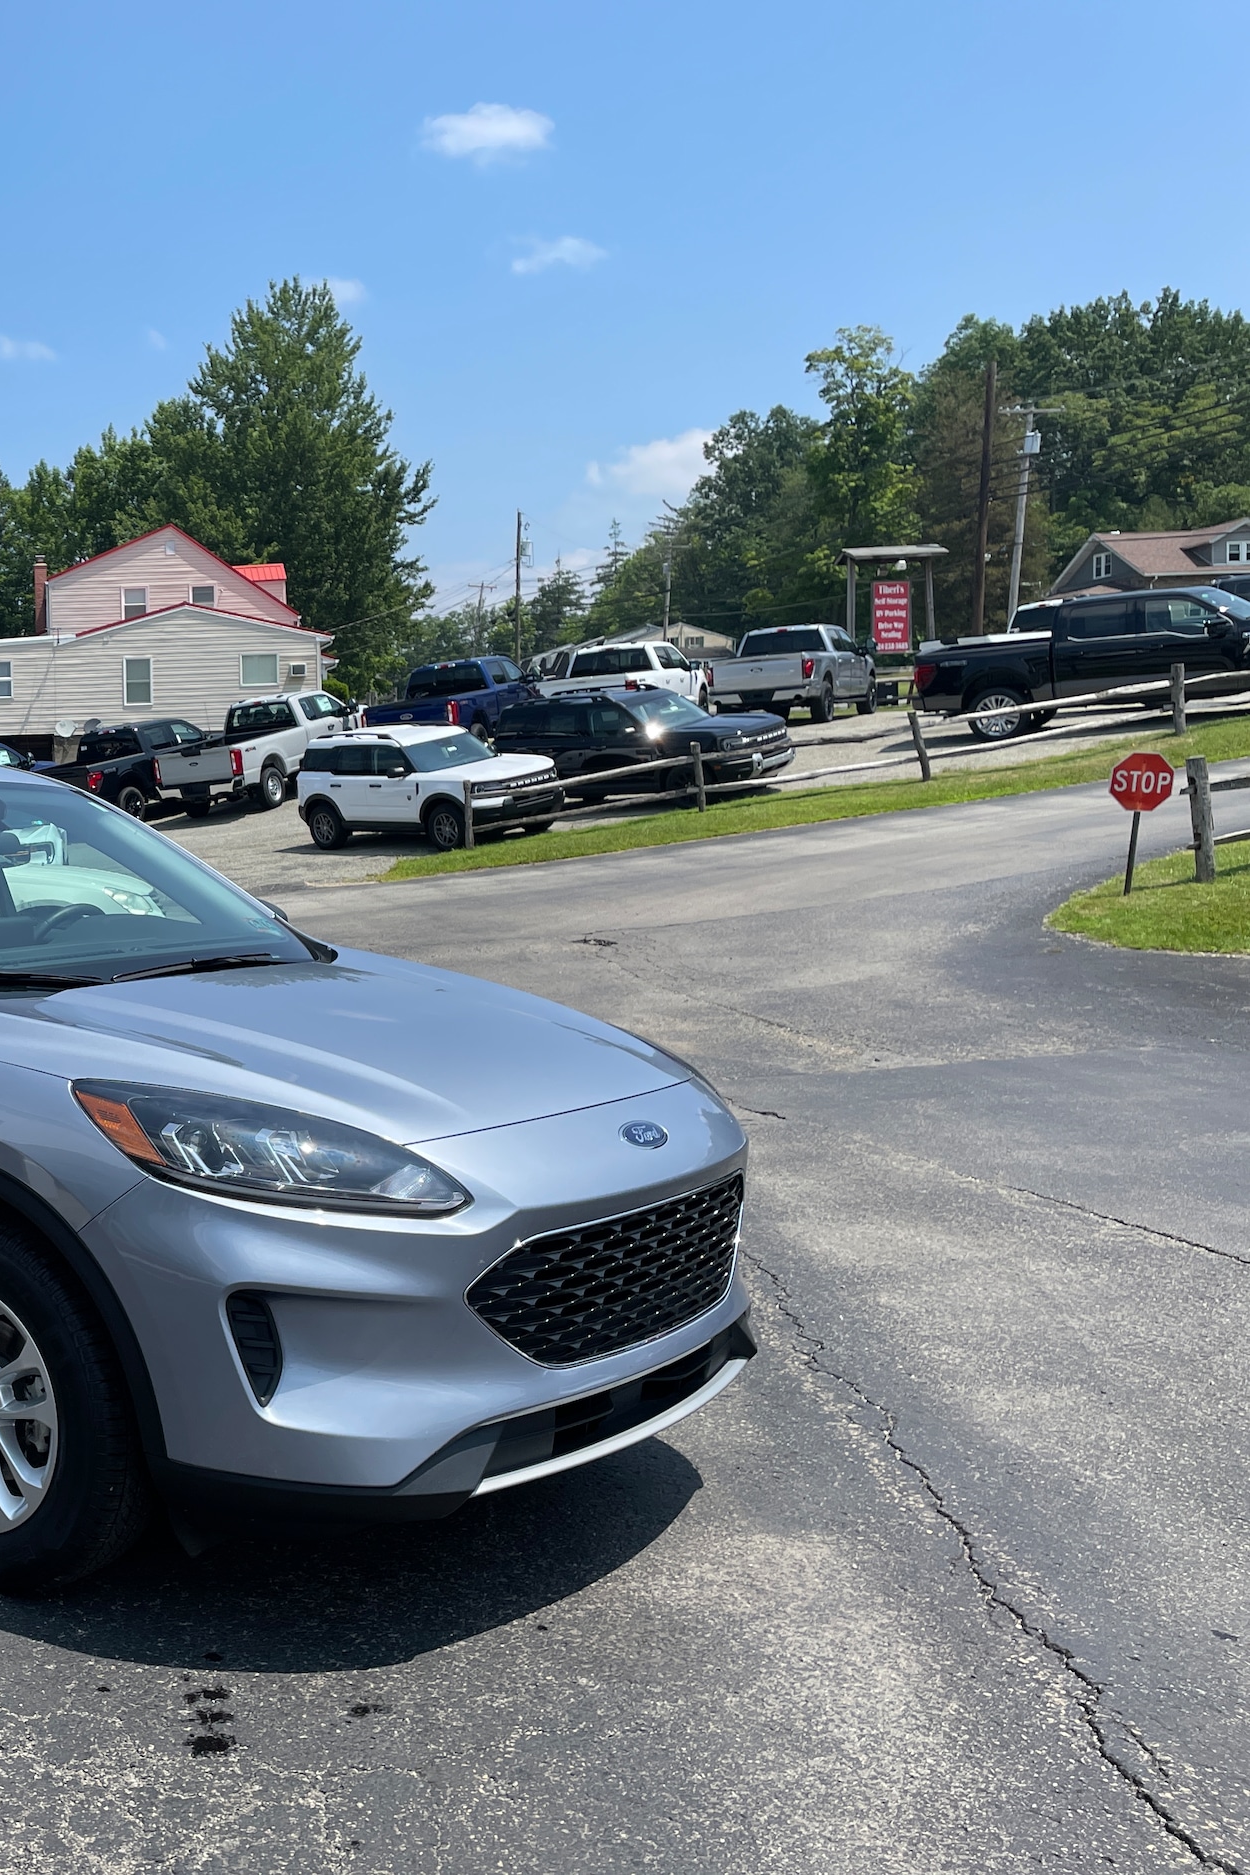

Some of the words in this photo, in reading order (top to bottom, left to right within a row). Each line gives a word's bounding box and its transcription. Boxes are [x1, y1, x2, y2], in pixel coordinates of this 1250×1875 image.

[874, 597, 886, 605] Self
[886, 597, 908, 606] Storage
[884, 608, 906, 618] Parking
[878, 621, 893, 630] Drive
[1113, 770, 1171, 793] STOP
[631, 1125, 661, 1143] Ford
